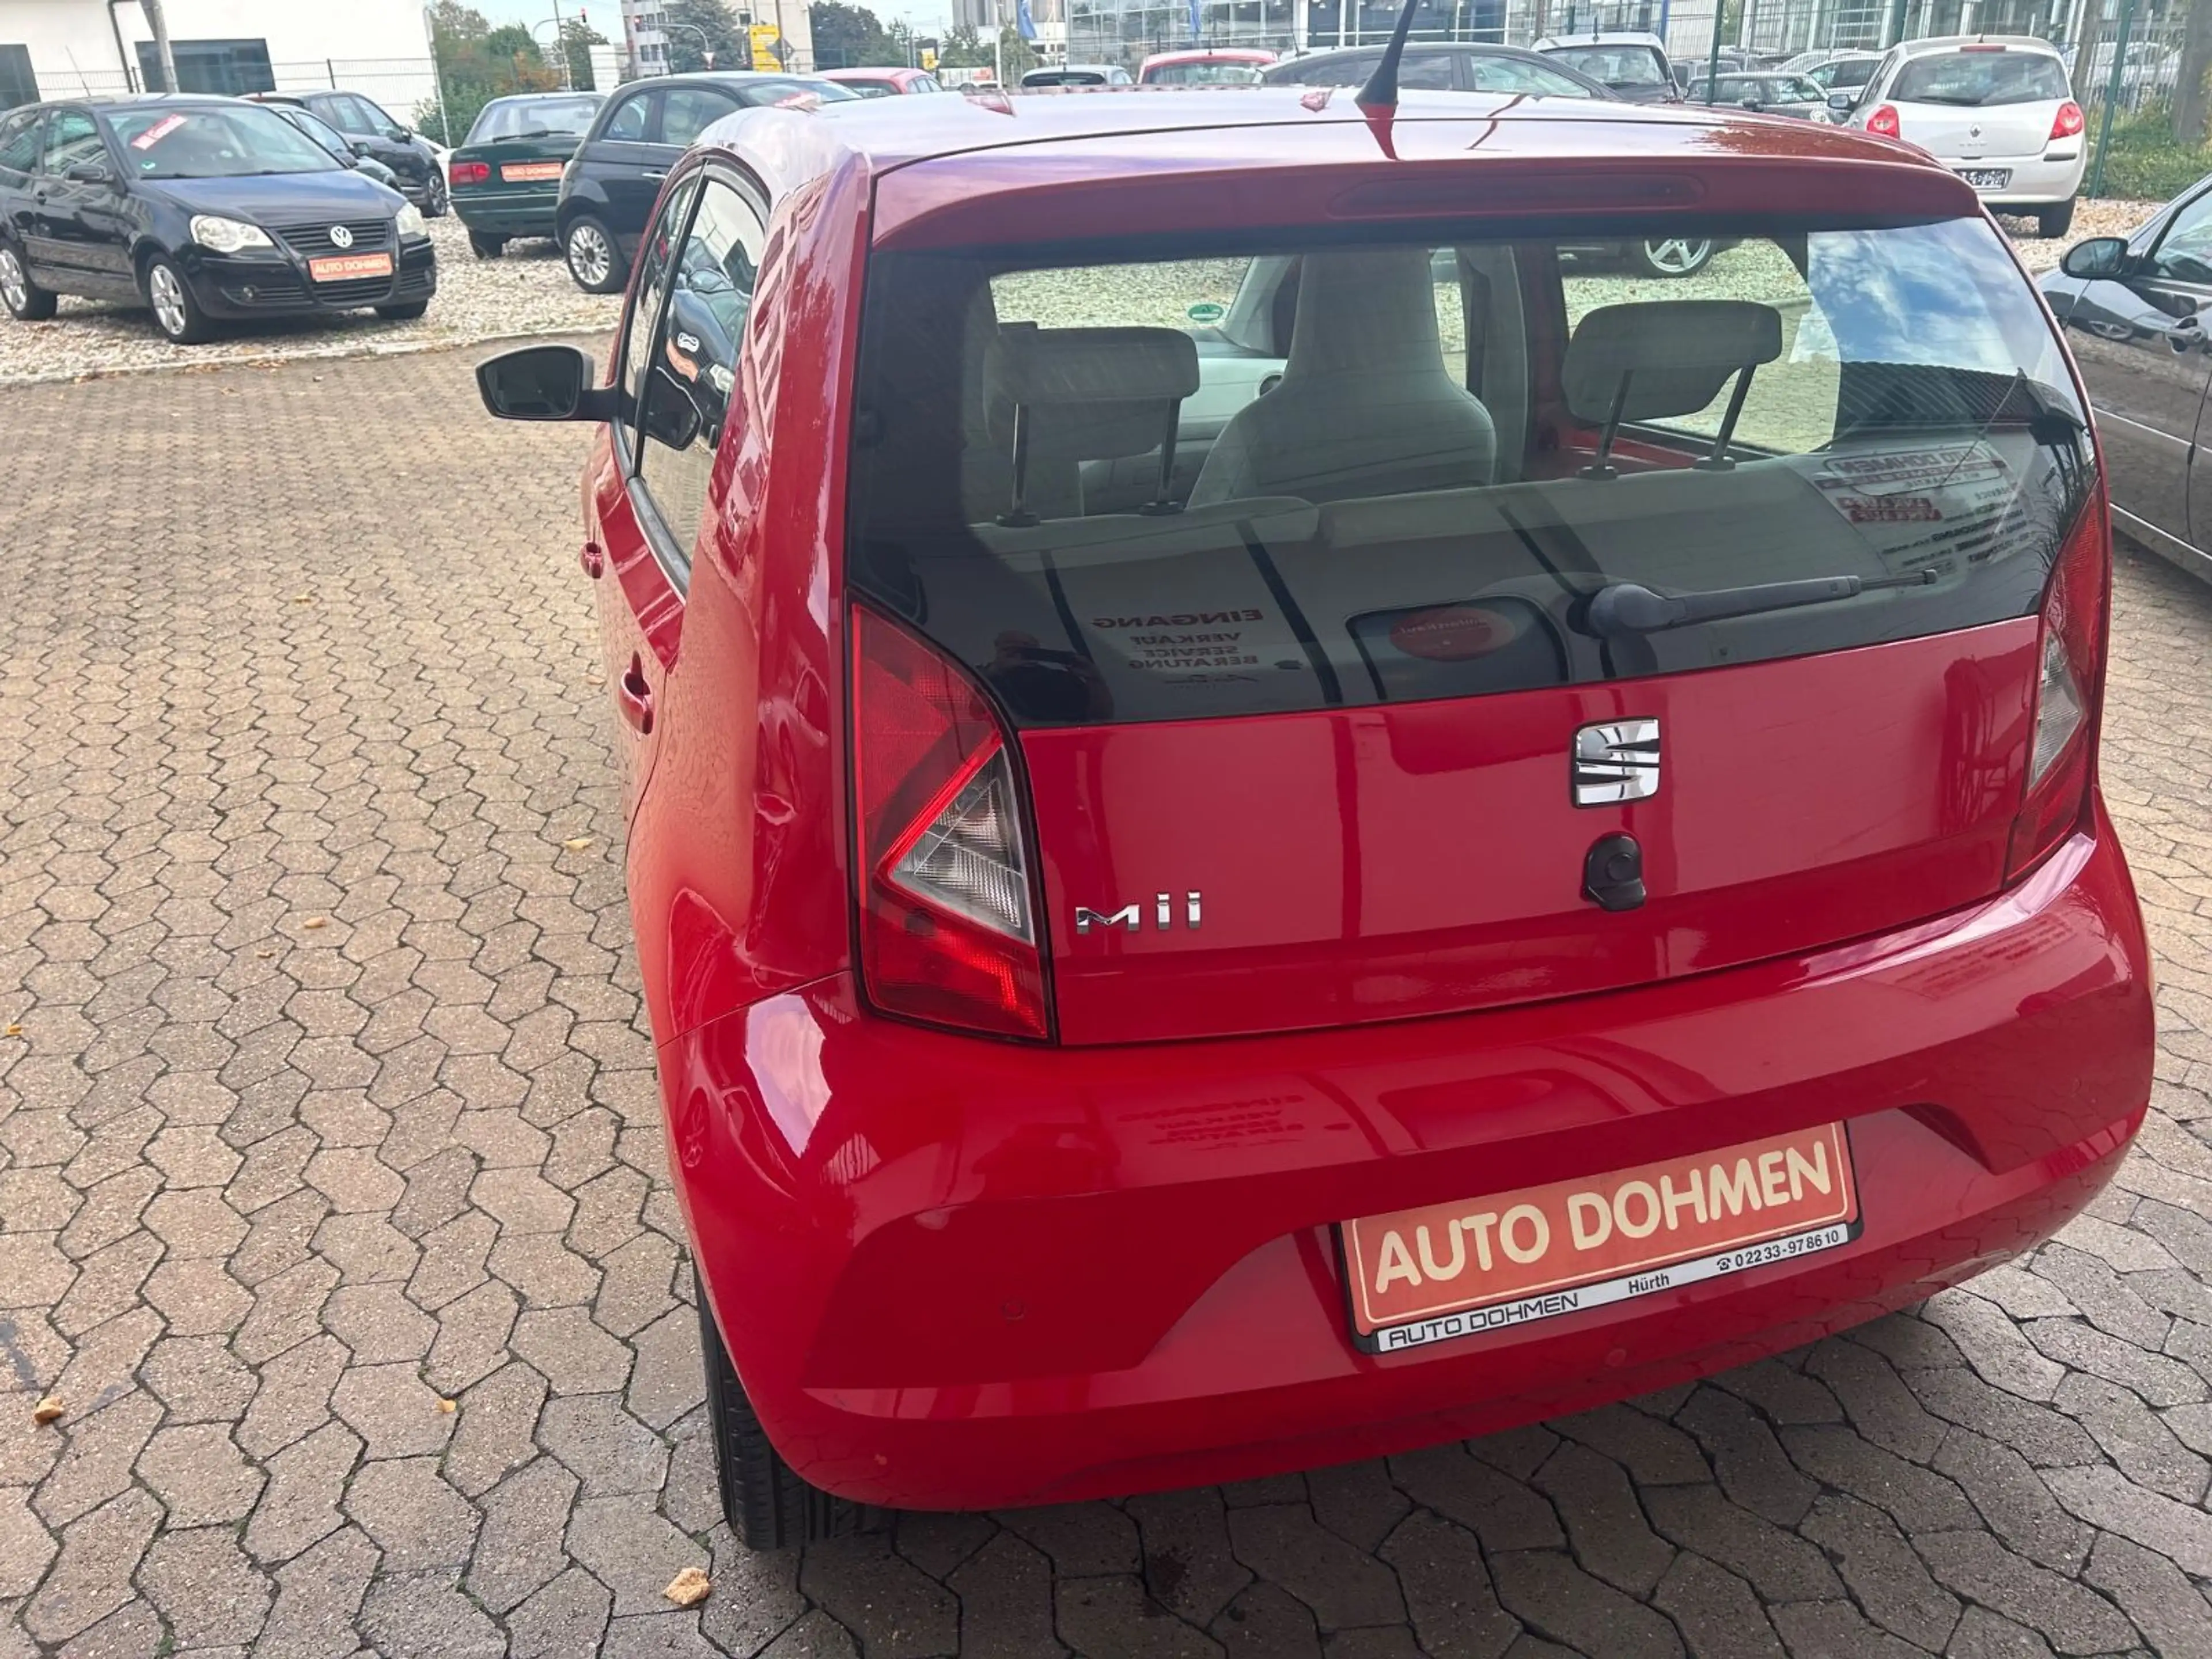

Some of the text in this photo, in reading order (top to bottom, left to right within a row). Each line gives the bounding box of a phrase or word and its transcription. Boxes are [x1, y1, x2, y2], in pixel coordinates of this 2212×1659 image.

[1075, 891, 1201, 934] Mii
[1375, 1140, 1832, 1294] AUTO DOHMEN
[1388, 1317, 1463, 1348] AUTO
[1469, 1292, 1579, 1330] DOHMEN
[1628, 1272, 1671, 1294] Hürth
